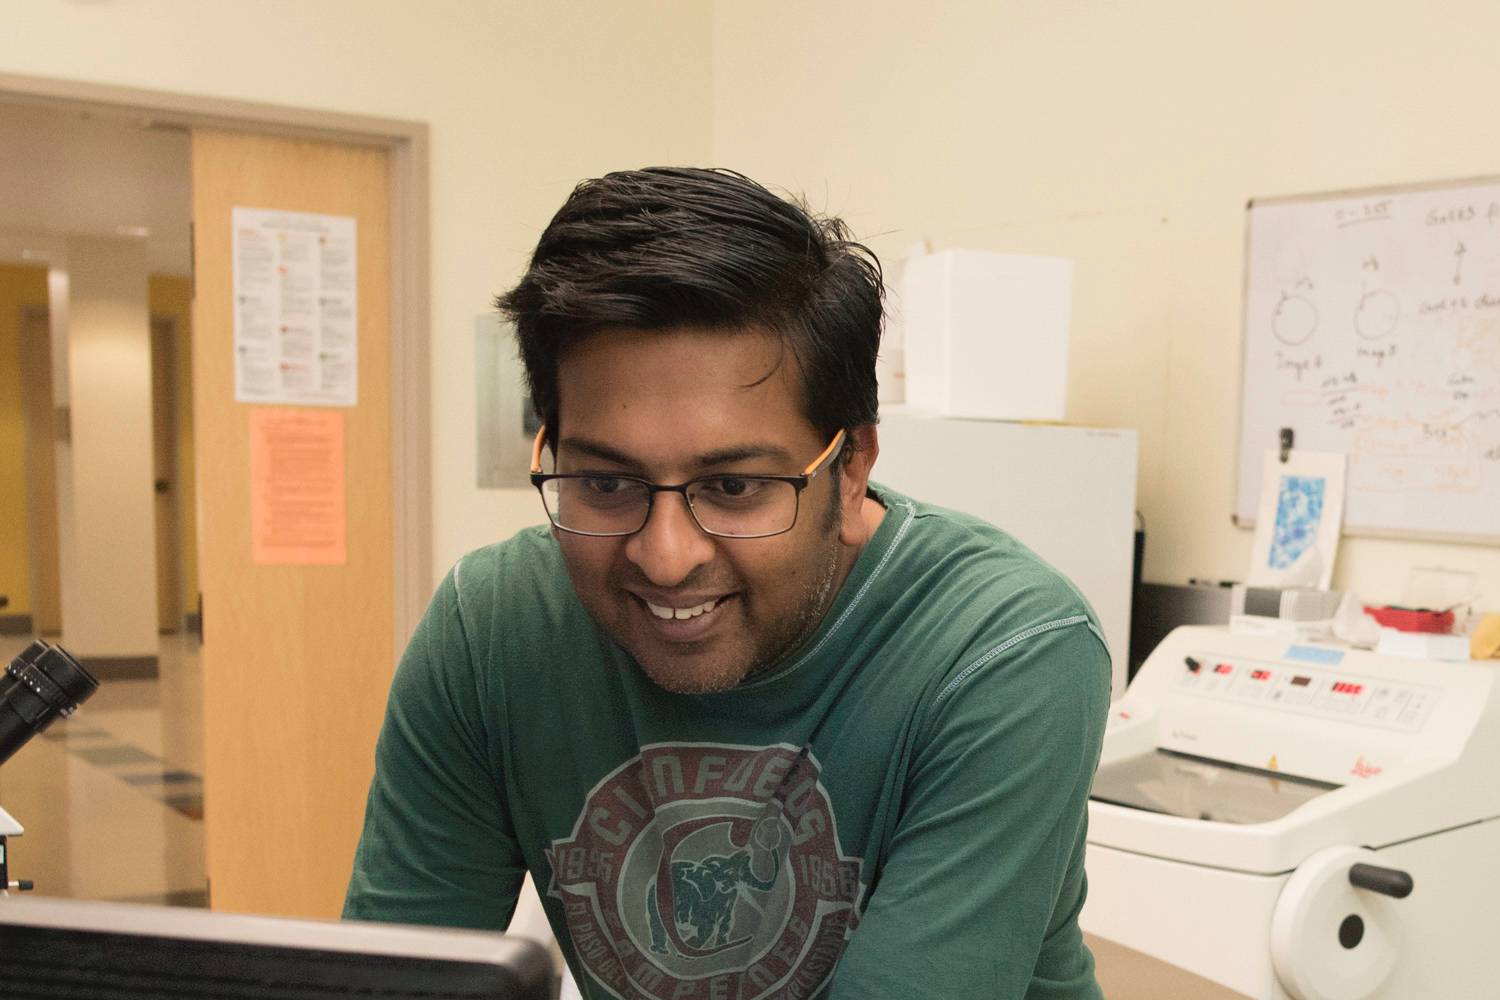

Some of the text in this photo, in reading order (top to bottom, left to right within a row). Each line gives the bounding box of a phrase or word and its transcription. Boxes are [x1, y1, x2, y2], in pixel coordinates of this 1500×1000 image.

[590, 755, 826, 847] CINFUEOS
[571, 921, 609, 961] PASO
[604, 910, 809, 1000] CAMPENES
